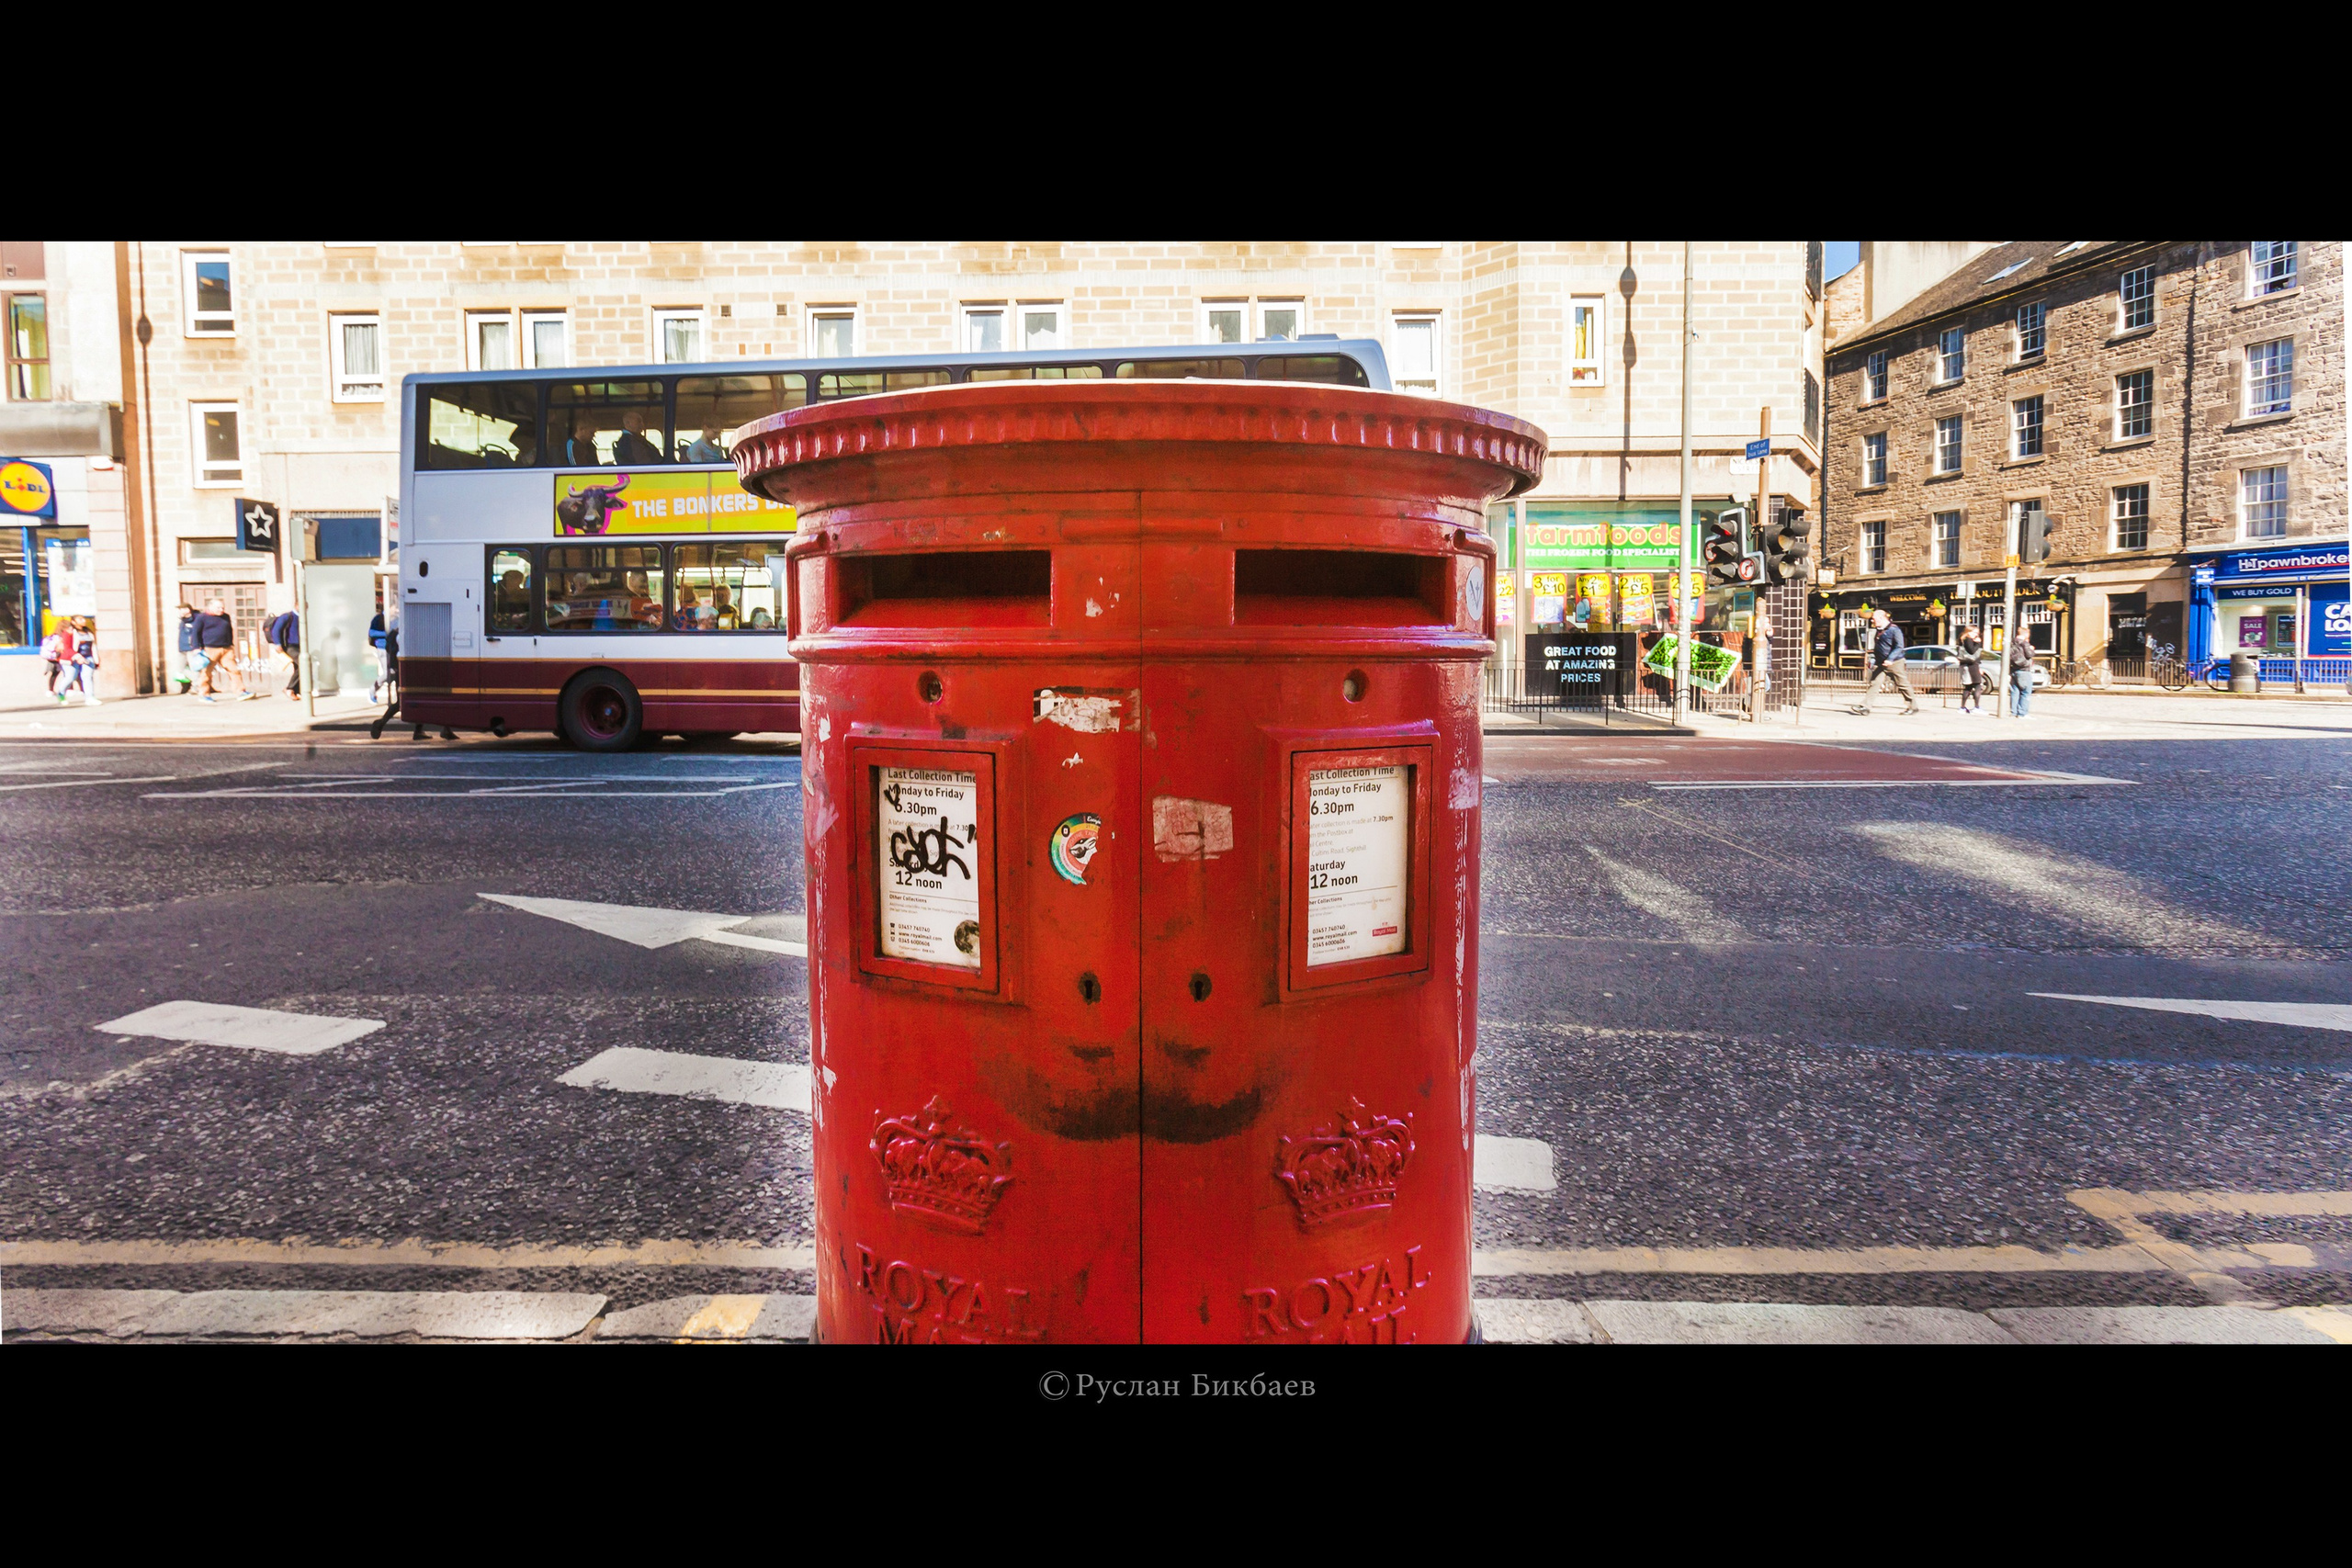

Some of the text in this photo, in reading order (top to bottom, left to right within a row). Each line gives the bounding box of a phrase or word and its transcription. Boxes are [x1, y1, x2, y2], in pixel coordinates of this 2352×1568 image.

[632, 499, 667, 518] THE
[673, 493, 759, 516] BONKERS
[1526, 522, 1681, 546] farmfoods
[1534, 577, 1543, 589] 3
[1591, 576, 1598, 584] 2
[1621, 577, 1629, 590] 2
[1543, 583, 1566, 594] £10
[1630, 582, 1649, 596] £5
[1692, 583, 1701, 594] 5
[1889, 593, 1928, 603] WELCOME
[2324, 618, 2351, 632] LO
[1544, 645, 1617, 658] GREAT FOOD
[1545, 659, 1615, 671] AT AMAZING
[1561, 673, 1601, 682] PRICES
[888, 769, 907, 779] Last
[909, 770, 953, 782] Collection
[1310, 766, 1395, 781] ast Collection Time
[924, 788, 933, 796] to
[935, 787, 965, 800] Friday
[1309, 783, 1382, 797] onday to Friday
[894, 798, 937, 817] 6.30pm
[1310, 800, 1354, 815] 6.30pm
[1309, 860, 1346, 872] aturday
[895, 870, 943, 889] 12 noon
[1310, 873, 1358, 889] 12 noon
[1317, 897, 1343, 905] Collections
[1312, 924, 1346, 934] 03457 740740
[1312, 930, 1357, 941] www.royalmail.com
[899, 931, 943, 942] www.royalmail.com
[856, 1242, 1049, 1337] ROYAL
[1242, 1244, 1431, 1335] ROYAL
